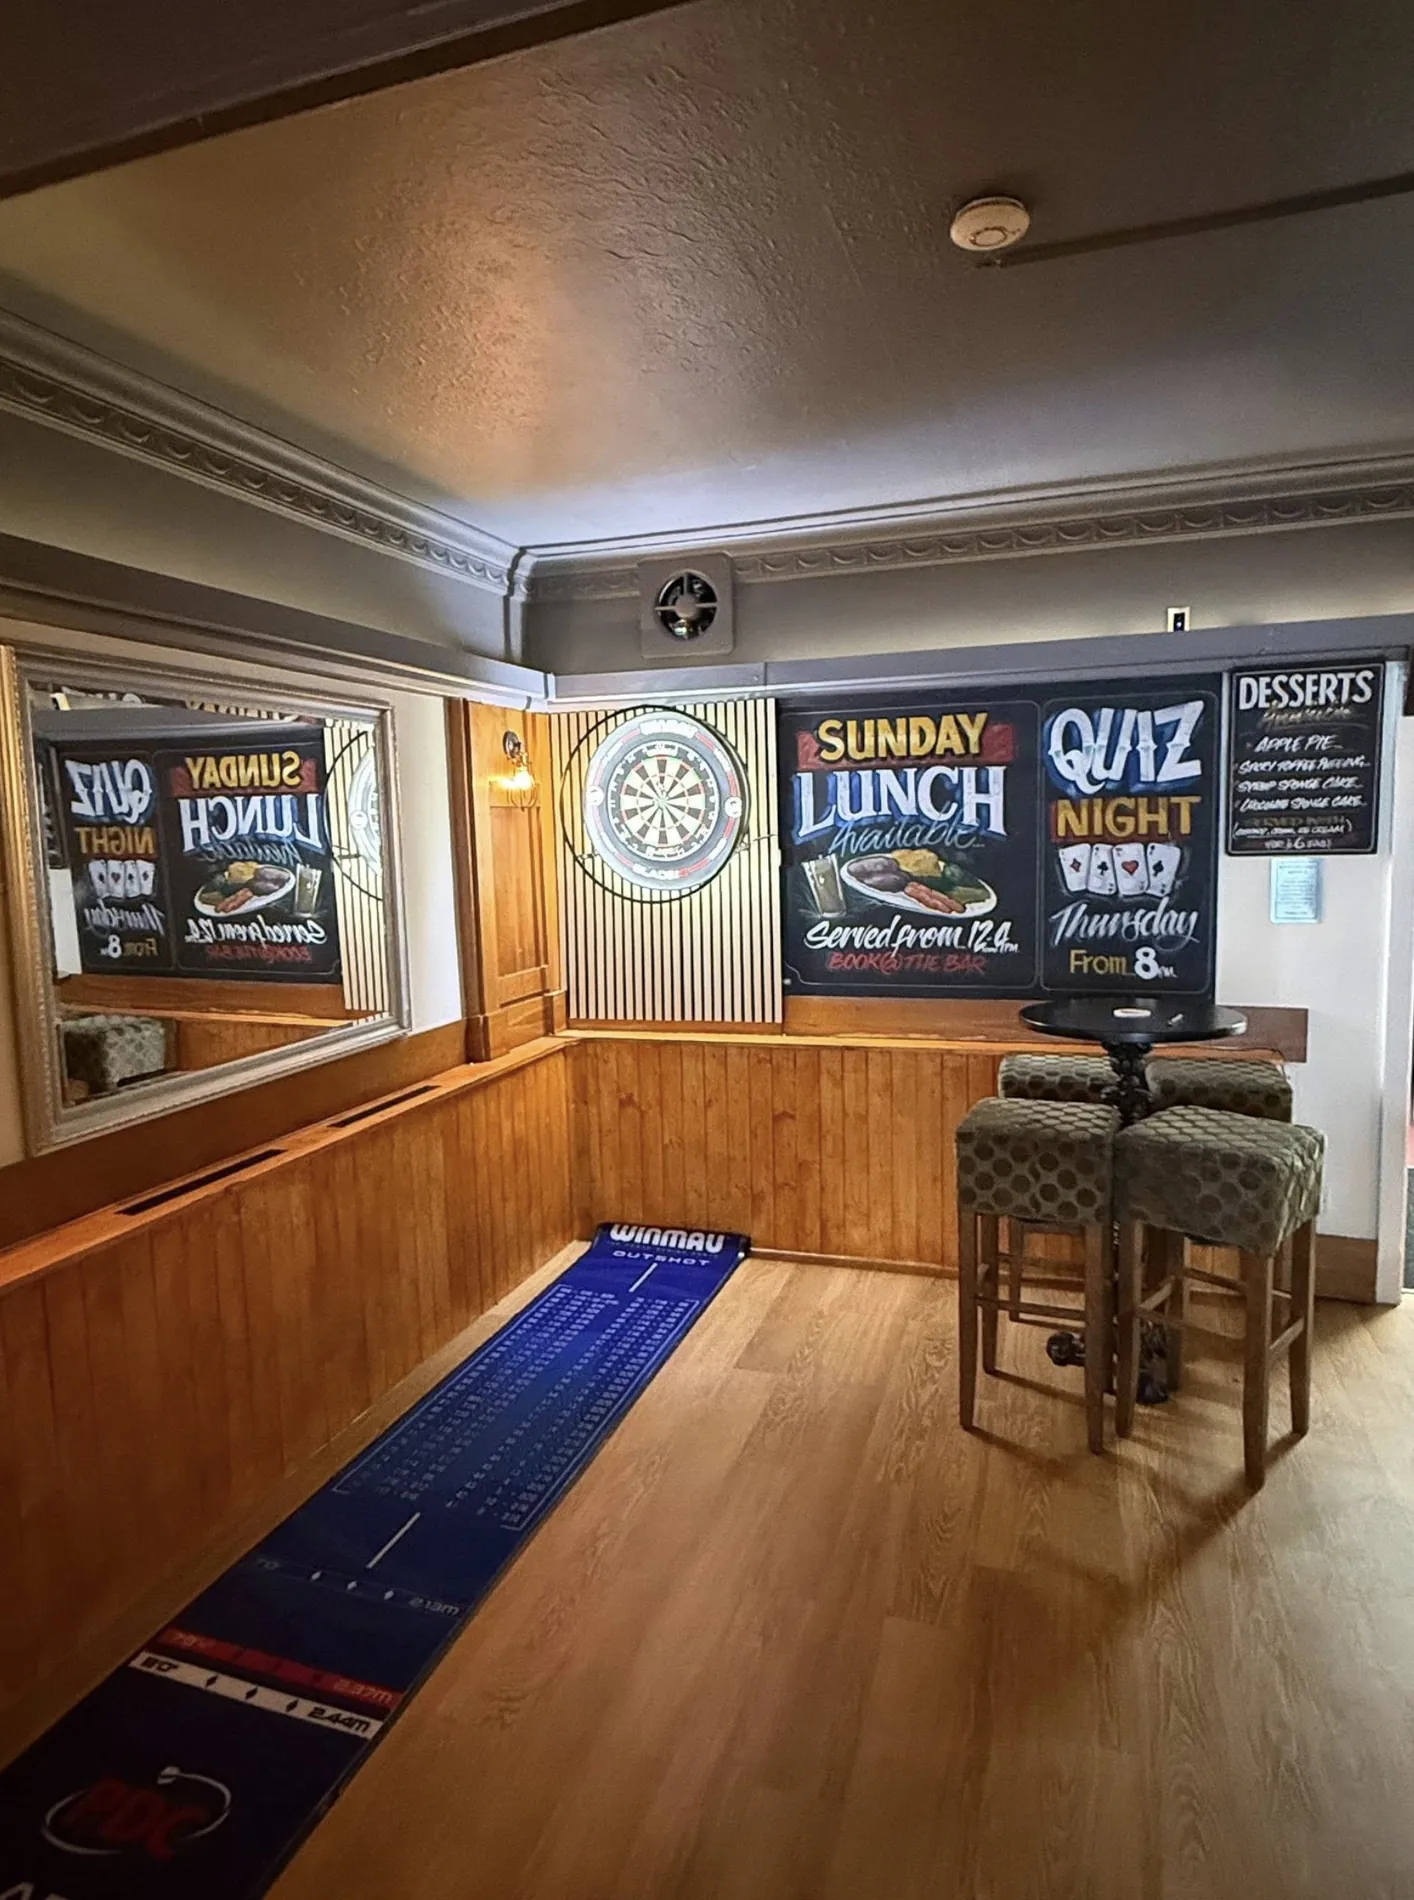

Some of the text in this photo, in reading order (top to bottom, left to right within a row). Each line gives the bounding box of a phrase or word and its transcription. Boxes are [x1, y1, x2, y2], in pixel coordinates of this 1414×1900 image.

[1239, 670, 1374, 710] DESSERTS
[818, 712, 988, 762] SUNDAY
[1047, 700, 1204, 794] QUIZ
[1254, 734, 1336, 752] APPLE PIE
[795, 765, 1008, 838] LUNCH
[1057, 796, 1201, 837] NIGHT
[828, 801, 980, 857] Available
[804, 915, 900, 950] Served
[890, 926, 962, 958] from
[1049, 896, 1200, 951] Thursday
[944, 953, 988, 974] BAR
[1069, 950, 1128, 975] From
[610, 1224, 725, 1253] WINMAU
[612, 1250, 711, 1266] OUTSHOT
[307, 1706, 372, 1733] 2.44m
